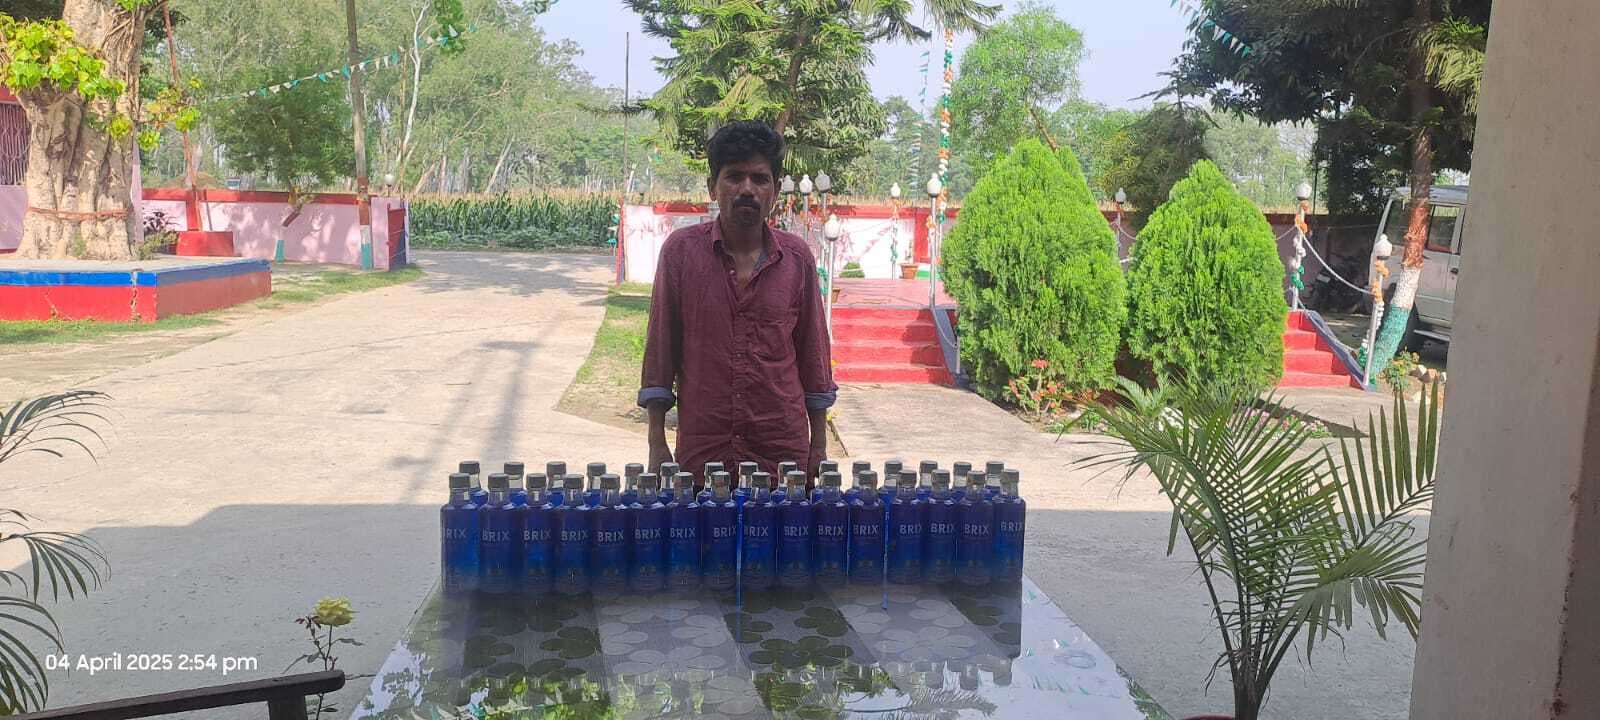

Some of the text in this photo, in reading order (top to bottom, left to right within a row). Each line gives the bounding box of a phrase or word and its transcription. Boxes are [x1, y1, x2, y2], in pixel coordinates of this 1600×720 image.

[482, 528, 510, 542] BRIX
[523, 529, 552, 541] BRIX
[634, 528, 661, 540] BRIX
[670, 527, 696, 539] BRIX
[713, 524, 737, 538] BRIX
[783, 525, 809, 537] BRIX
[818, 524, 844, 537] BRIX
[853, 523, 879, 535] BRIX
[964, 523, 990, 535] BRIX
[561, 530, 588, 541] BRIX
[597, 529, 624, 542] BRIX
